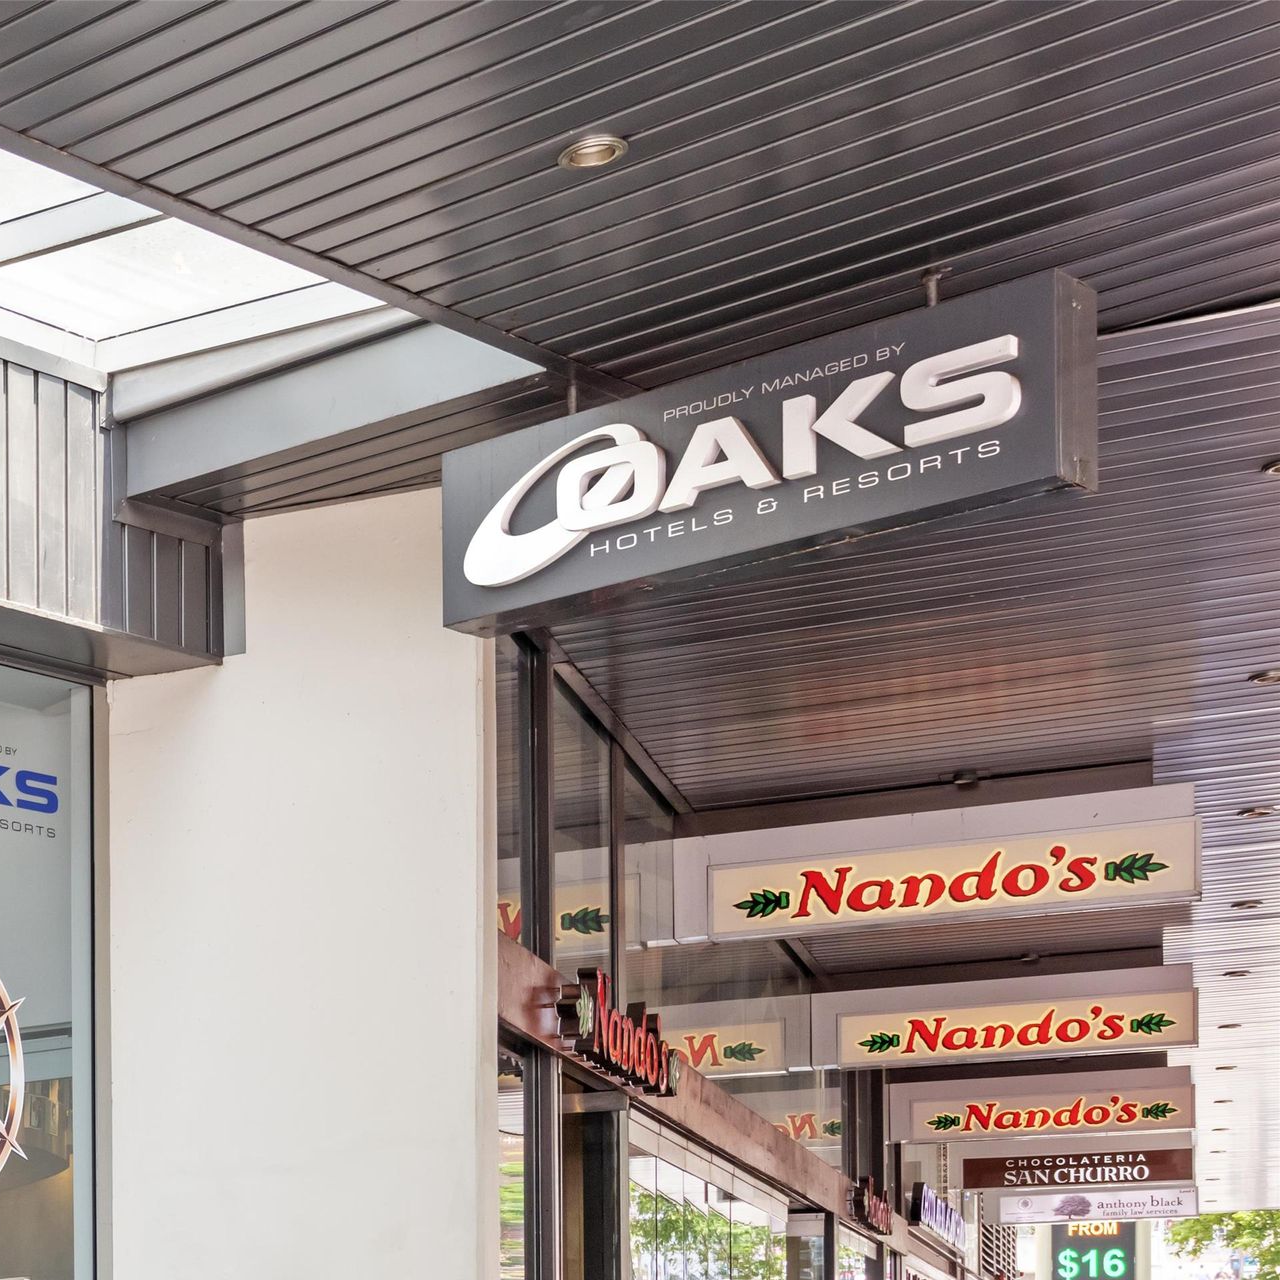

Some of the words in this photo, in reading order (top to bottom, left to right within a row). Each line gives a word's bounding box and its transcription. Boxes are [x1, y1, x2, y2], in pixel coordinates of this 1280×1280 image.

[663, 385, 755, 422] PROUDLY
[761, 355, 870, 395] MANAGED
[876, 341, 907, 363] BY
[556, 333, 1022, 531] OAKS
[590, 507, 735, 557] HOTELS
[756, 497, 778, 515] &
[803, 440, 1002, 503] RESORTS
[5, 745, 18, 756] BY
[791, 845, 1098, 919] Nando's
[593, 967, 669, 1094] Nando's
[900, 1005, 1127, 1054] Nando's
[961, 1095, 1139, 1132] Nando's
[1004, 1168, 1050, 1186] SAN
[1054, 1164, 1149, 1184] CHURRO
[1006, 1153, 1146, 1168] CHOCOLATERIA
[1097, 1199, 1148, 1211] anthony
[1150, 1195, 1183, 1208] black
[1102, 1209, 1129, 1218] family
[1146, 1208, 1178, 1216] services
[1068, 1221, 1119, 1236] FROM
[1058, 1248, 1126, 1280] $16
